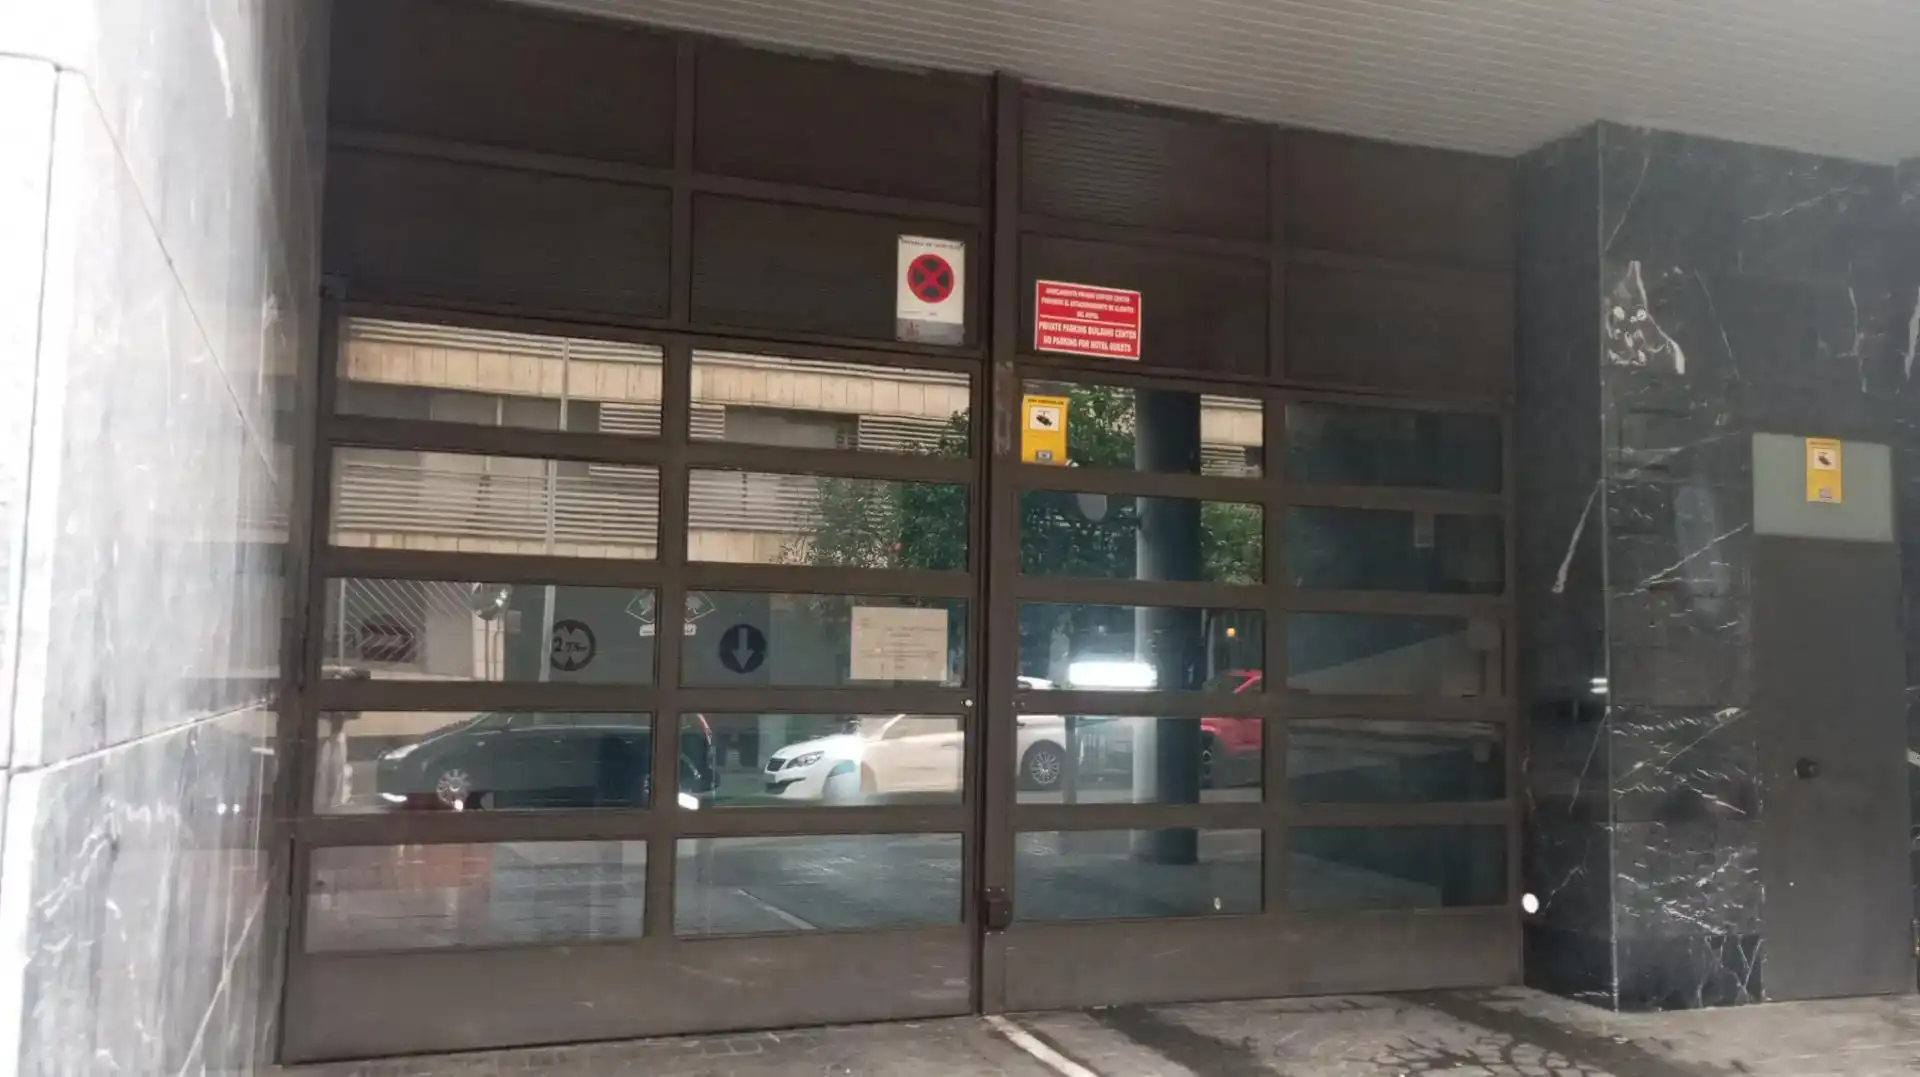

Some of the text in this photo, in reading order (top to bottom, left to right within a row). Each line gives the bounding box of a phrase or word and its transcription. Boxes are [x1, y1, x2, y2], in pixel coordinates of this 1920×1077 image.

[1039, 321, 1137, 340] PRIVATE PARKING BUILDING CENTER
[1043, 335, 1132, 352] NO PARKING FOR HOTEL GUESTS
